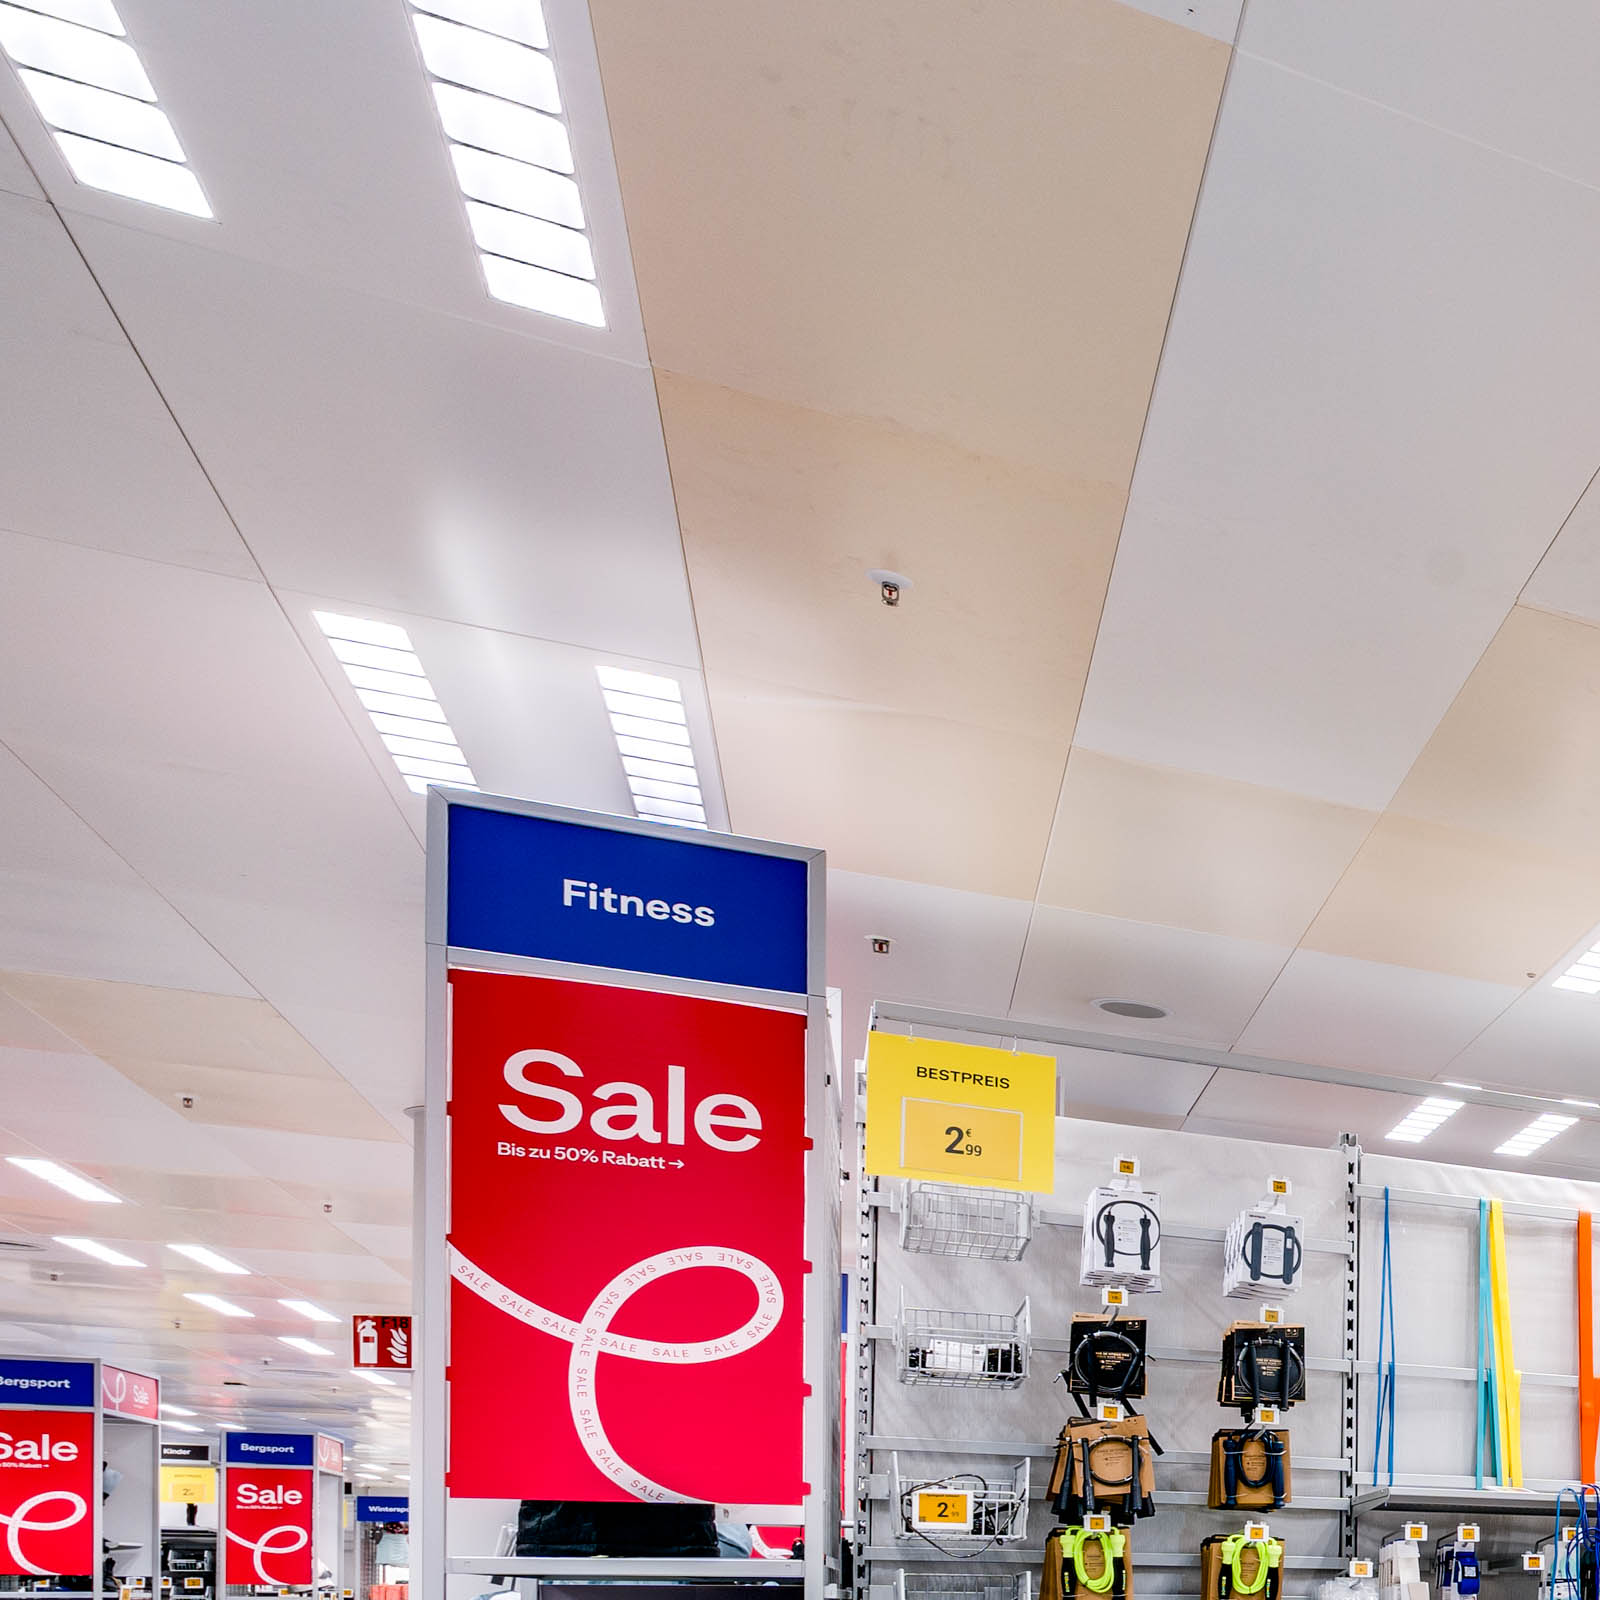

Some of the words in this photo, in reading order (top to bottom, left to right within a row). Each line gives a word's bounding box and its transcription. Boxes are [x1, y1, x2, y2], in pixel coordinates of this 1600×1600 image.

[562, 878, 716, 927] Fitness
[915, 1065, 1011, 1090] BESTPREIS
[497, 1048, 763, 1153] Sale
[944, 1126, 966, 1155] 2
[965, 1144, 983, 1157] 99
[497, 1141, 526, 1158] Bis
[528, 1147, 551, 1160] zu
[553, 1146, 600, 1164] 50%
[601, 1151, 666, 1170] Rabatt
[666, 1251, 704, 1266] SALE
[716, 1251, 754, 1270] SALE
[458, 1264, 491, 1293] SALE
[623, 1263, 657, 1288] SALE
[759, 1274, 777, 1304] SALE
[499, 1294, 535, 1319] SALE
[594, 1291, 621, 1319] SALE
[381, 1316, 409, 1329] F18
[541, 1315, 578, 1338] SALE
[746, 1312, 774, 1340] SALE
[579, 1327, 598, 1358] SALE
[600, 1337, 638, 1354] SALE
[652, 1346, 690, 1359] SALE
[703, 1338, 739, 1357] SALE
[576, 1367, 589, 1399] SALE
[579, 1408, 598, 1440] SALE
[163, 1447, 191, 1457] Kinder
[240, 1443, 295, 1454] Bergsport
[596, 1447, 623, 1477] SALE
[236, 1483, 303, 1505] Sale
[629, 1479, 665, 1502] SALE
[937, 1502, 949, 1518] 2
